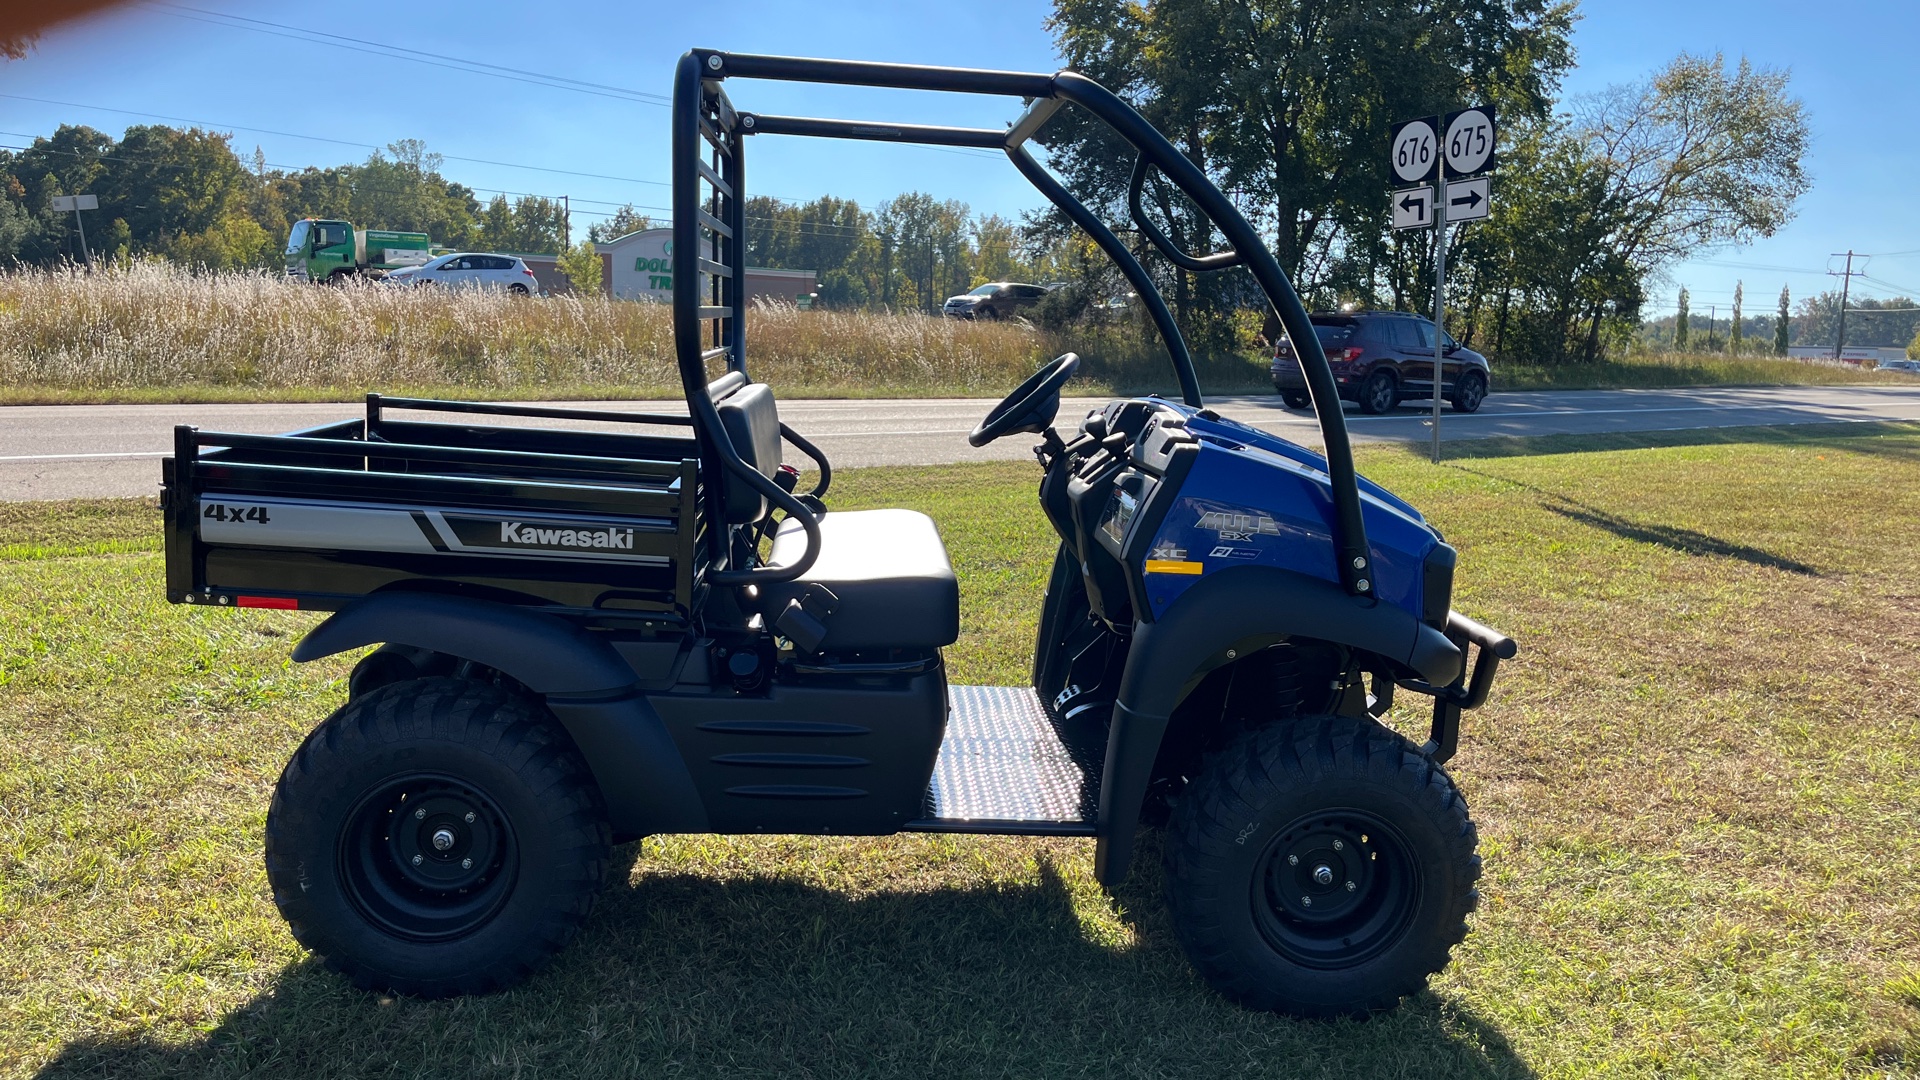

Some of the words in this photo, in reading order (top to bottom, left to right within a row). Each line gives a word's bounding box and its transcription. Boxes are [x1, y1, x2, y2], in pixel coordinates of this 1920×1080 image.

[1398, 135, 1429, 168] 676
[1451, 125, 1486, 159] 675
[635, 257, 672, 274] DOL
[648, 275, 672, 291] TR
[203, 504, 271, 525] 4x4
[1194, 511, 1281, 536] MULE
[500, 521, 634, 550] Kawasaki
[1219, 530, 1253, 543] SX
[1152, 548, 1187, 559] XC
